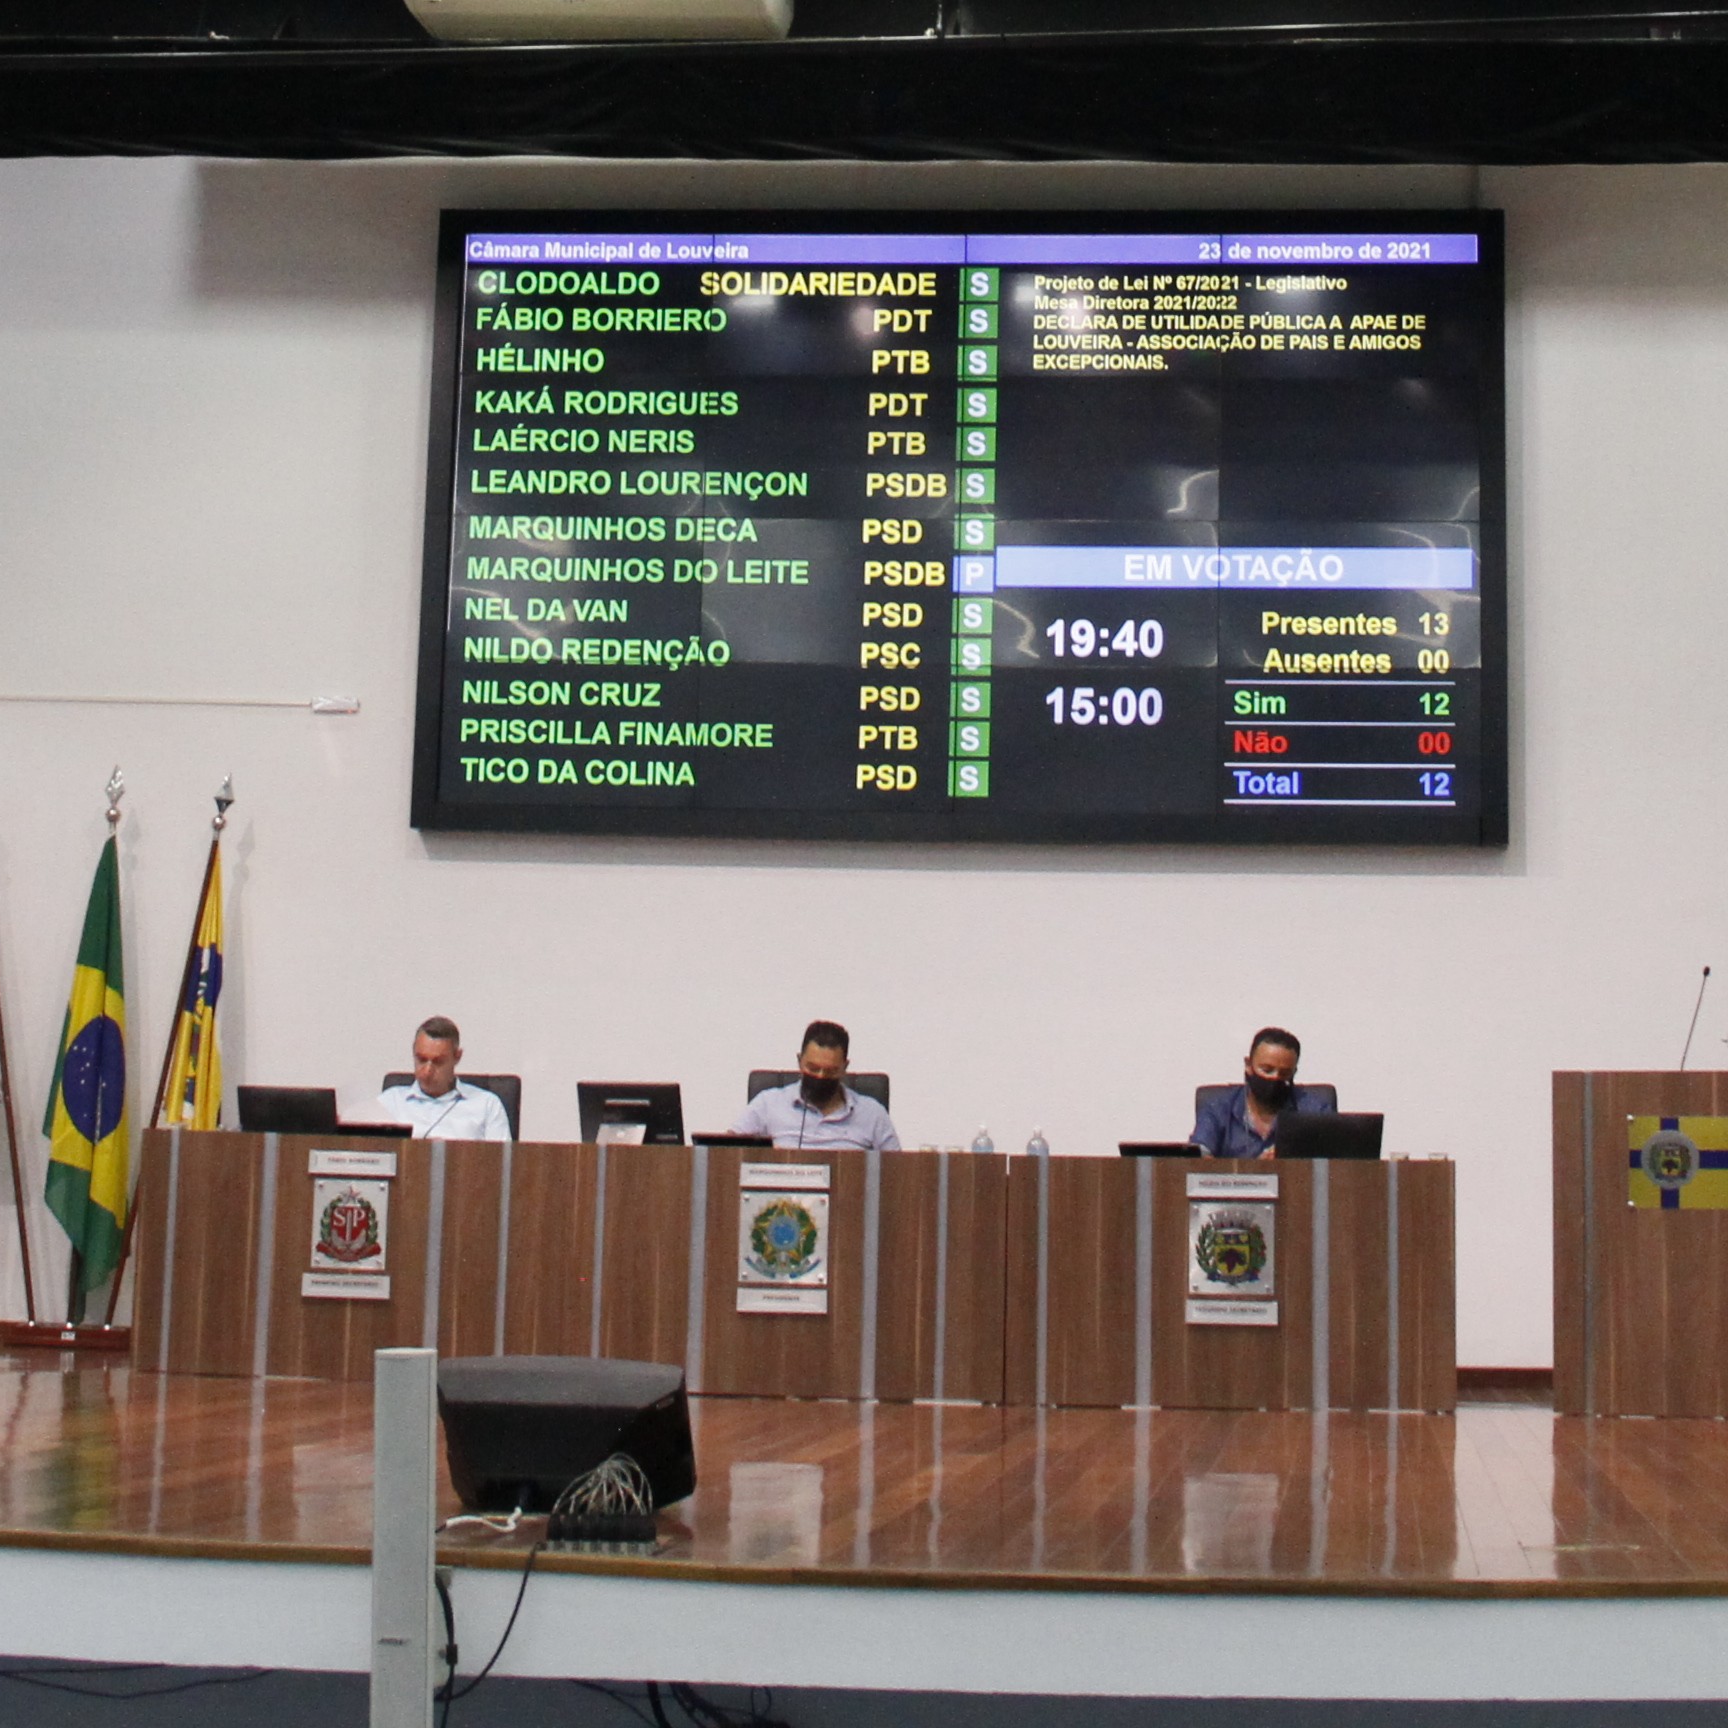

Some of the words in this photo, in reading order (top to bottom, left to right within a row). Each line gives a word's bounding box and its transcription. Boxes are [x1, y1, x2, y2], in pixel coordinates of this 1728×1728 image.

[469, 240, 540, 259] Câmara
[544, 240, 634, 262] Municipal
[639, 241, 661, 259] de
[667, 241, 749, 259] Louveira
[1198, 242, 1221, 260] 23
[1228, 242, 1252, 260] de
[1256, 242, 1352, 260] novembro
[1356, 242, 1382, 260] de
[1386, 242, 1432, 260] 2021
[478, 271, 660, 296] CLODOALDO
[700, 272, 937, 296] SOLIDARIEDADE
[970, 272, 989, 296] S
[1034, 275, 1094, 293] Projeto
[1099, 275, 1118, 290] de
[1124, 275, 1148, 290] Lei
[1153, 275, 1172, 290] Nº
[1176, 275, 1239, 290] 67/2021
[1256, 275, 1347, 293] Legislativo
[1034, 295, 1078, 310] Mesa
[1083, 295, 1149, 310] Diretora
[1154, 295, 1237, 310] 2021/2022
[476, 302, 564, 332] FÁBIO
[572, 308, 727, 333] BORRIERO
[873, 309, 932, 333] PDT
[969, 309, 988, 334] S
[1033, 315, 1118, 330] DECLARA
[1122, 315, 1146, 329] DE
[1151, 315, 1244, 330] UTILIDADE
[1250, 311, 1326, 330] PÚBLICA
[1329, 315, 1342, 329] A
[1350, 315, 1397, 329] APAE
[1402, 315, 1426, 329] DE
[1033, 335, 1122, 350] LOUVEIRA
[1136, 332, 1256, 352] ASSOCIAÇÃO
[1261, 335, 1284, 349] DE
[1290, 335, 1328, 350] PAIS
[1334, 335, 1345, 349] E
[1349, 335, 1422, 350] AMIGOS
[476, 343, 605, 373] HÉLINHO
[872, 350, 931, 374] PTB
[969, 350, 988, 375] S
[1033, 354, 1169, 370] EXCEPCIONAIS.
[475, 385, 554, 415] KAKÁ
[564, 391, 739, 416] RODRIGUES
[868, 392, 928, 416] PDT
[968, 393, 987, 417] S
[473, 423, 599, 453] LAÉRCIO
[608, 429, 695, 453] NERIS
[867, 431, 927, 455] PTB
[967, 431, 986, 456] S
[472, 470, 612, 495] LEANDRO
[620, 471, 808, 501] LOURENÇON
[866, 472, 948, 498] PSDB
[966, 473, 985, 498] S
[469, 516, 666, 542] MARQUINHOS
[675, 518, 758, 543] DECA
[862, 519, 923, 545] PSD
[965, 520, 984, 545] S
[467, 557, 665, 584] MARQUINHOS
[674, 558, 718, 585] DO
[727, 559, 809, 584] LEITE
[864, 561, 946, 586] PSDB
[965, 562, 984, 586] P
[1124, 554, 1172, 581] EM
[1184, 549, 1343, 586] VOTAÇÃO
[465, 598, 519, 622] NEL
[527, 598, 567, 622] DA
[573, 599, 627, 622] VAN
[862, 603, 923, 627] PSD
[963, 603, 983, 628] S
[1262, 612, 1397, 636] Presentes
[1419, 613, 1449, 635] 13
[465, 638, 553, 664] NILDO
[562, 636, 730, 670] REDENÇÃO
[861, 642, 921, 669] PSC
[962, 643, 981, 670] S
[1046, 619, 1163, 658] 19:40
[1263, 650, 1391, 674] Ausentes
[1418, 652, 1449, 674] 00
[463, 681, 571, 706] NILSON
[579, 682, 661, 707] CRUZ
[860, 686, 920, 711] PSD
[961, 686, 980, 711] S
[1046, 687, 1163, 725] 15:00
[1233, 691, 1286, 715] Sim
[1420, 693, 1449, 716] 12
[461, 719, 611, 745] PRISCILLA
[620, 722, 773, 747] FINAMORE
[859, 725, 918, 750] PTB
[960, 726, 979, 751] S
[1233, 731, 1288, 754] Não
[1418, 732, 1450, 755] 00
[461, 758, 529, 782] TICO
[538, 758, 578, 783] DA
[585, 760, 695, 786] COLINA
[856, 765, 917, 790] PSD
[959, 765, 978, 790] S
[1233, 771, 1299, 795] Total
[1420, 773, 1449, 795] 12
